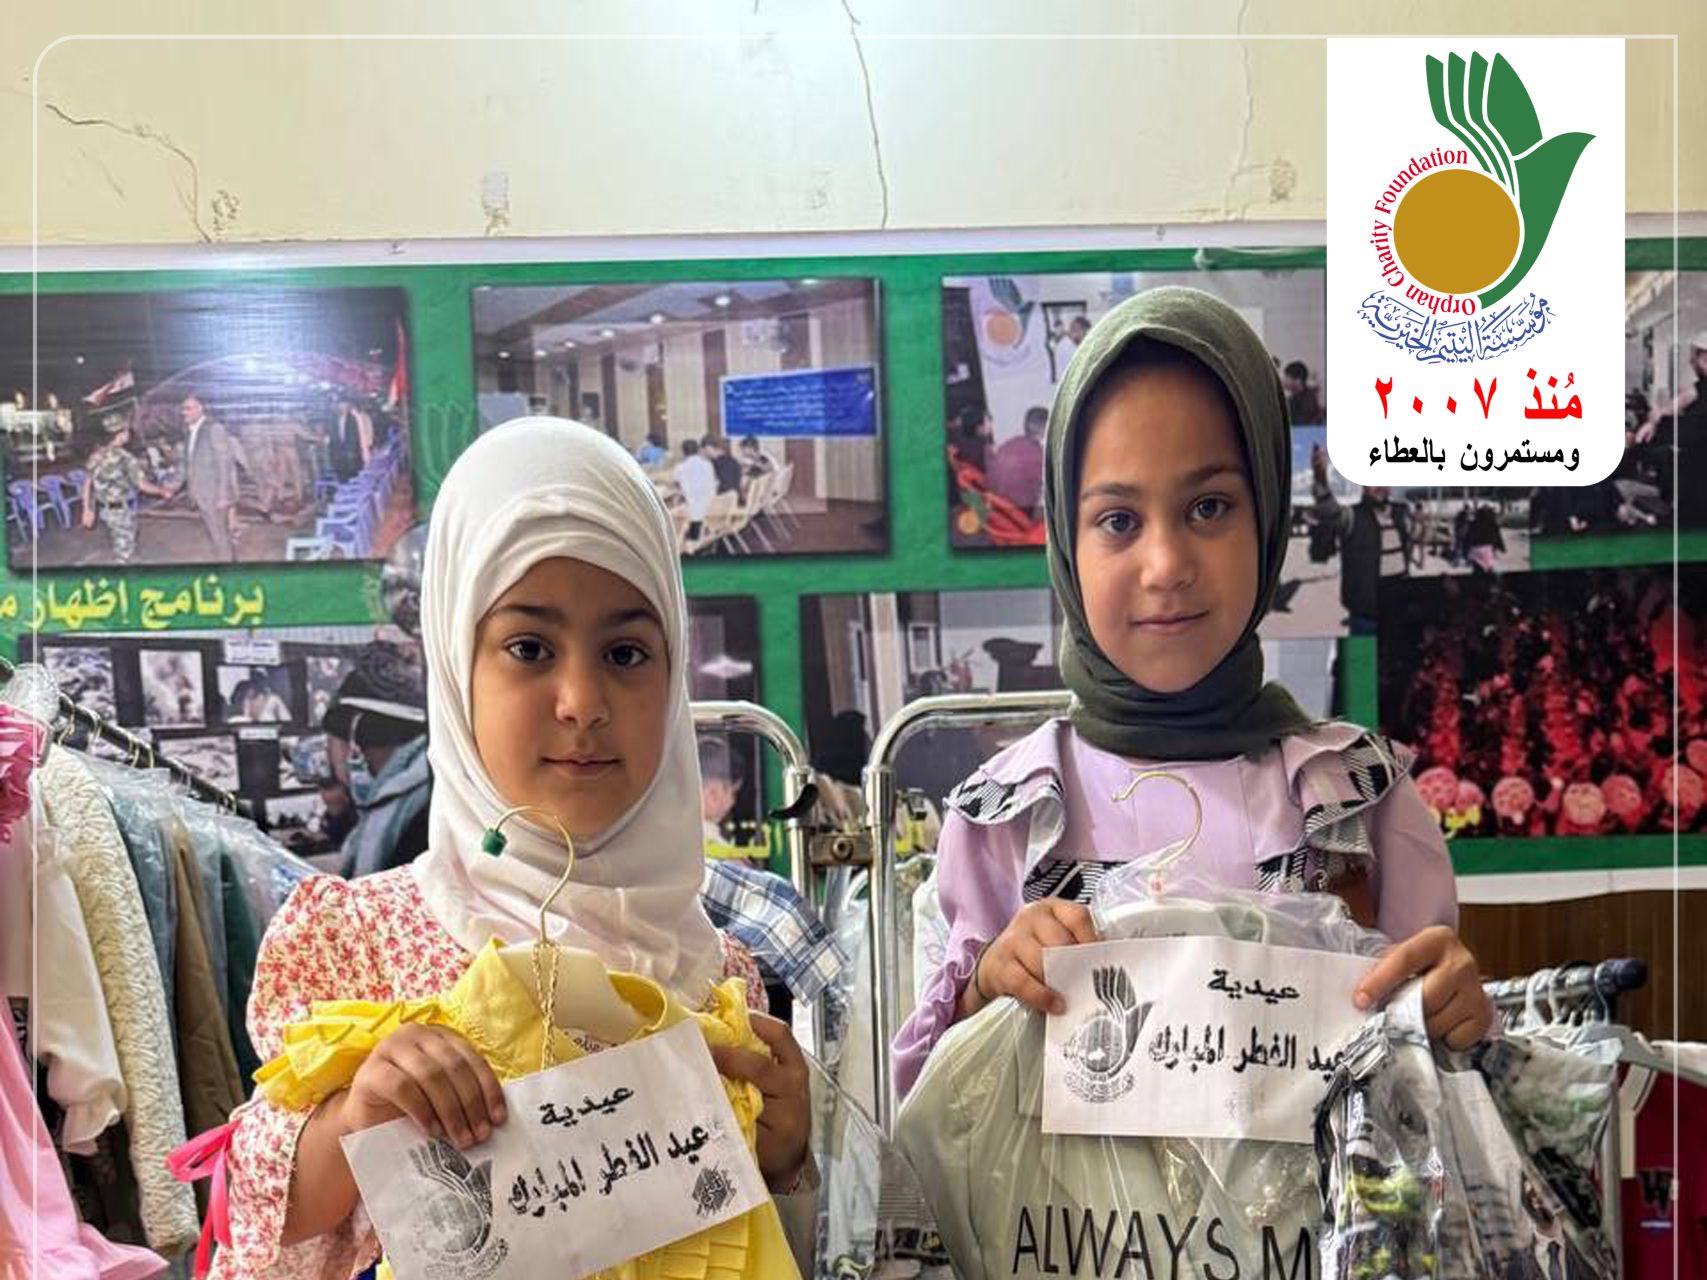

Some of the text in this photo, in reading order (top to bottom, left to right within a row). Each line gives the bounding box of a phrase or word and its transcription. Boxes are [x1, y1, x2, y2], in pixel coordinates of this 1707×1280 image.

[140, 574, 264, 628] برنامج
[1207, 968, 1301, 1005] عيدية
[1149, 1024, 1225, 1074] المبارك
[1233, 1025, 1296, 1073] الفطر
[540, 1085, 635, 1128] عيدية
[599, 1131, 660, 1195] الفطر
[667, 1126, 709, 1165] عيد
[508, 1156, 587, 1218] المبارك
